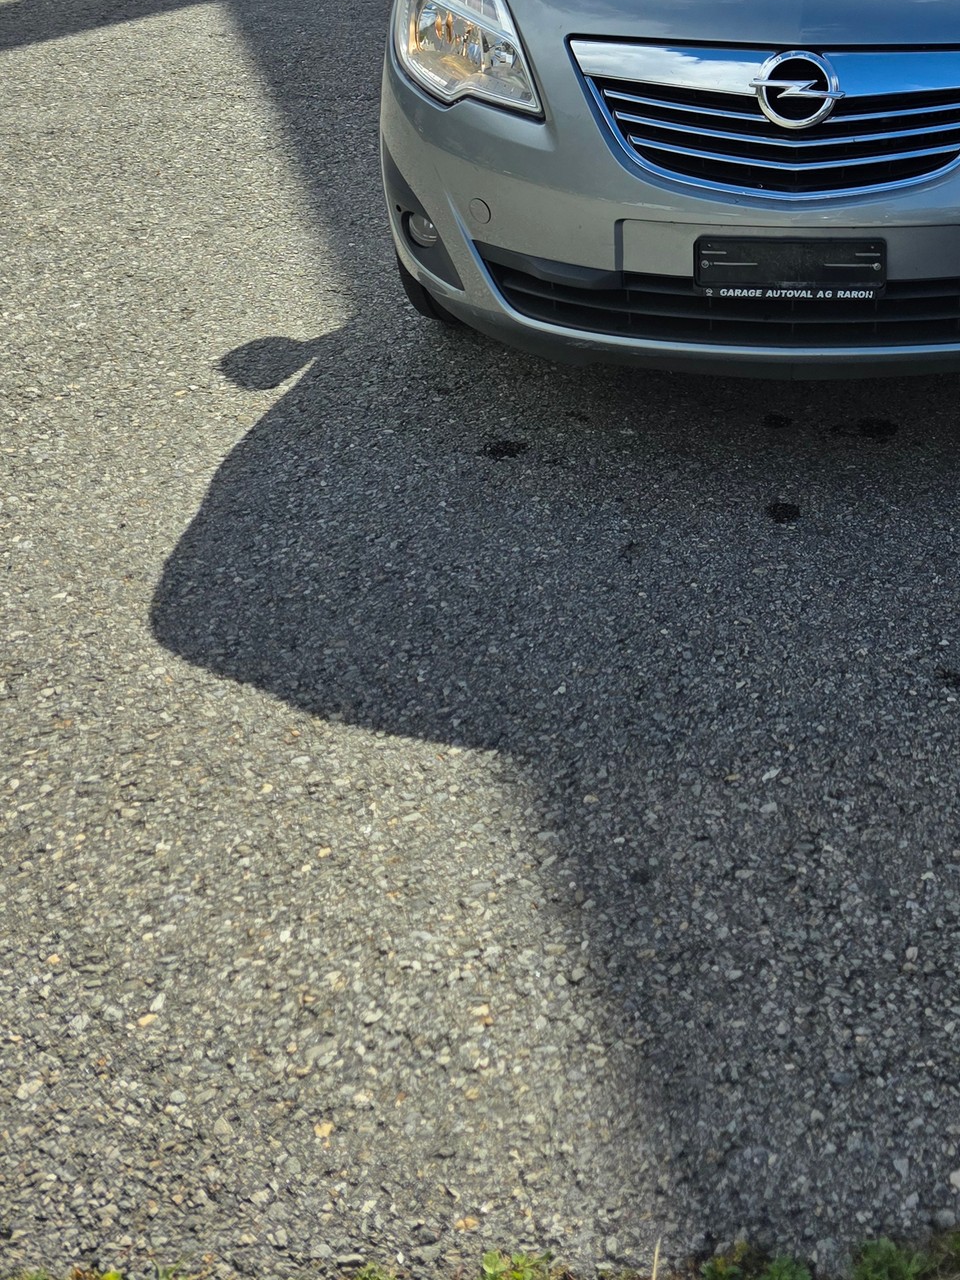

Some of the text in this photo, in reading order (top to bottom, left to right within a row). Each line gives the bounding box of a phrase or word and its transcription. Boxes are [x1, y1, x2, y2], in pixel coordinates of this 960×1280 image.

[720, 288, 762, 297] GARAGE
[765, 289, 813, 298] AUTOVAL
[816, 290, 833, 298] AG
